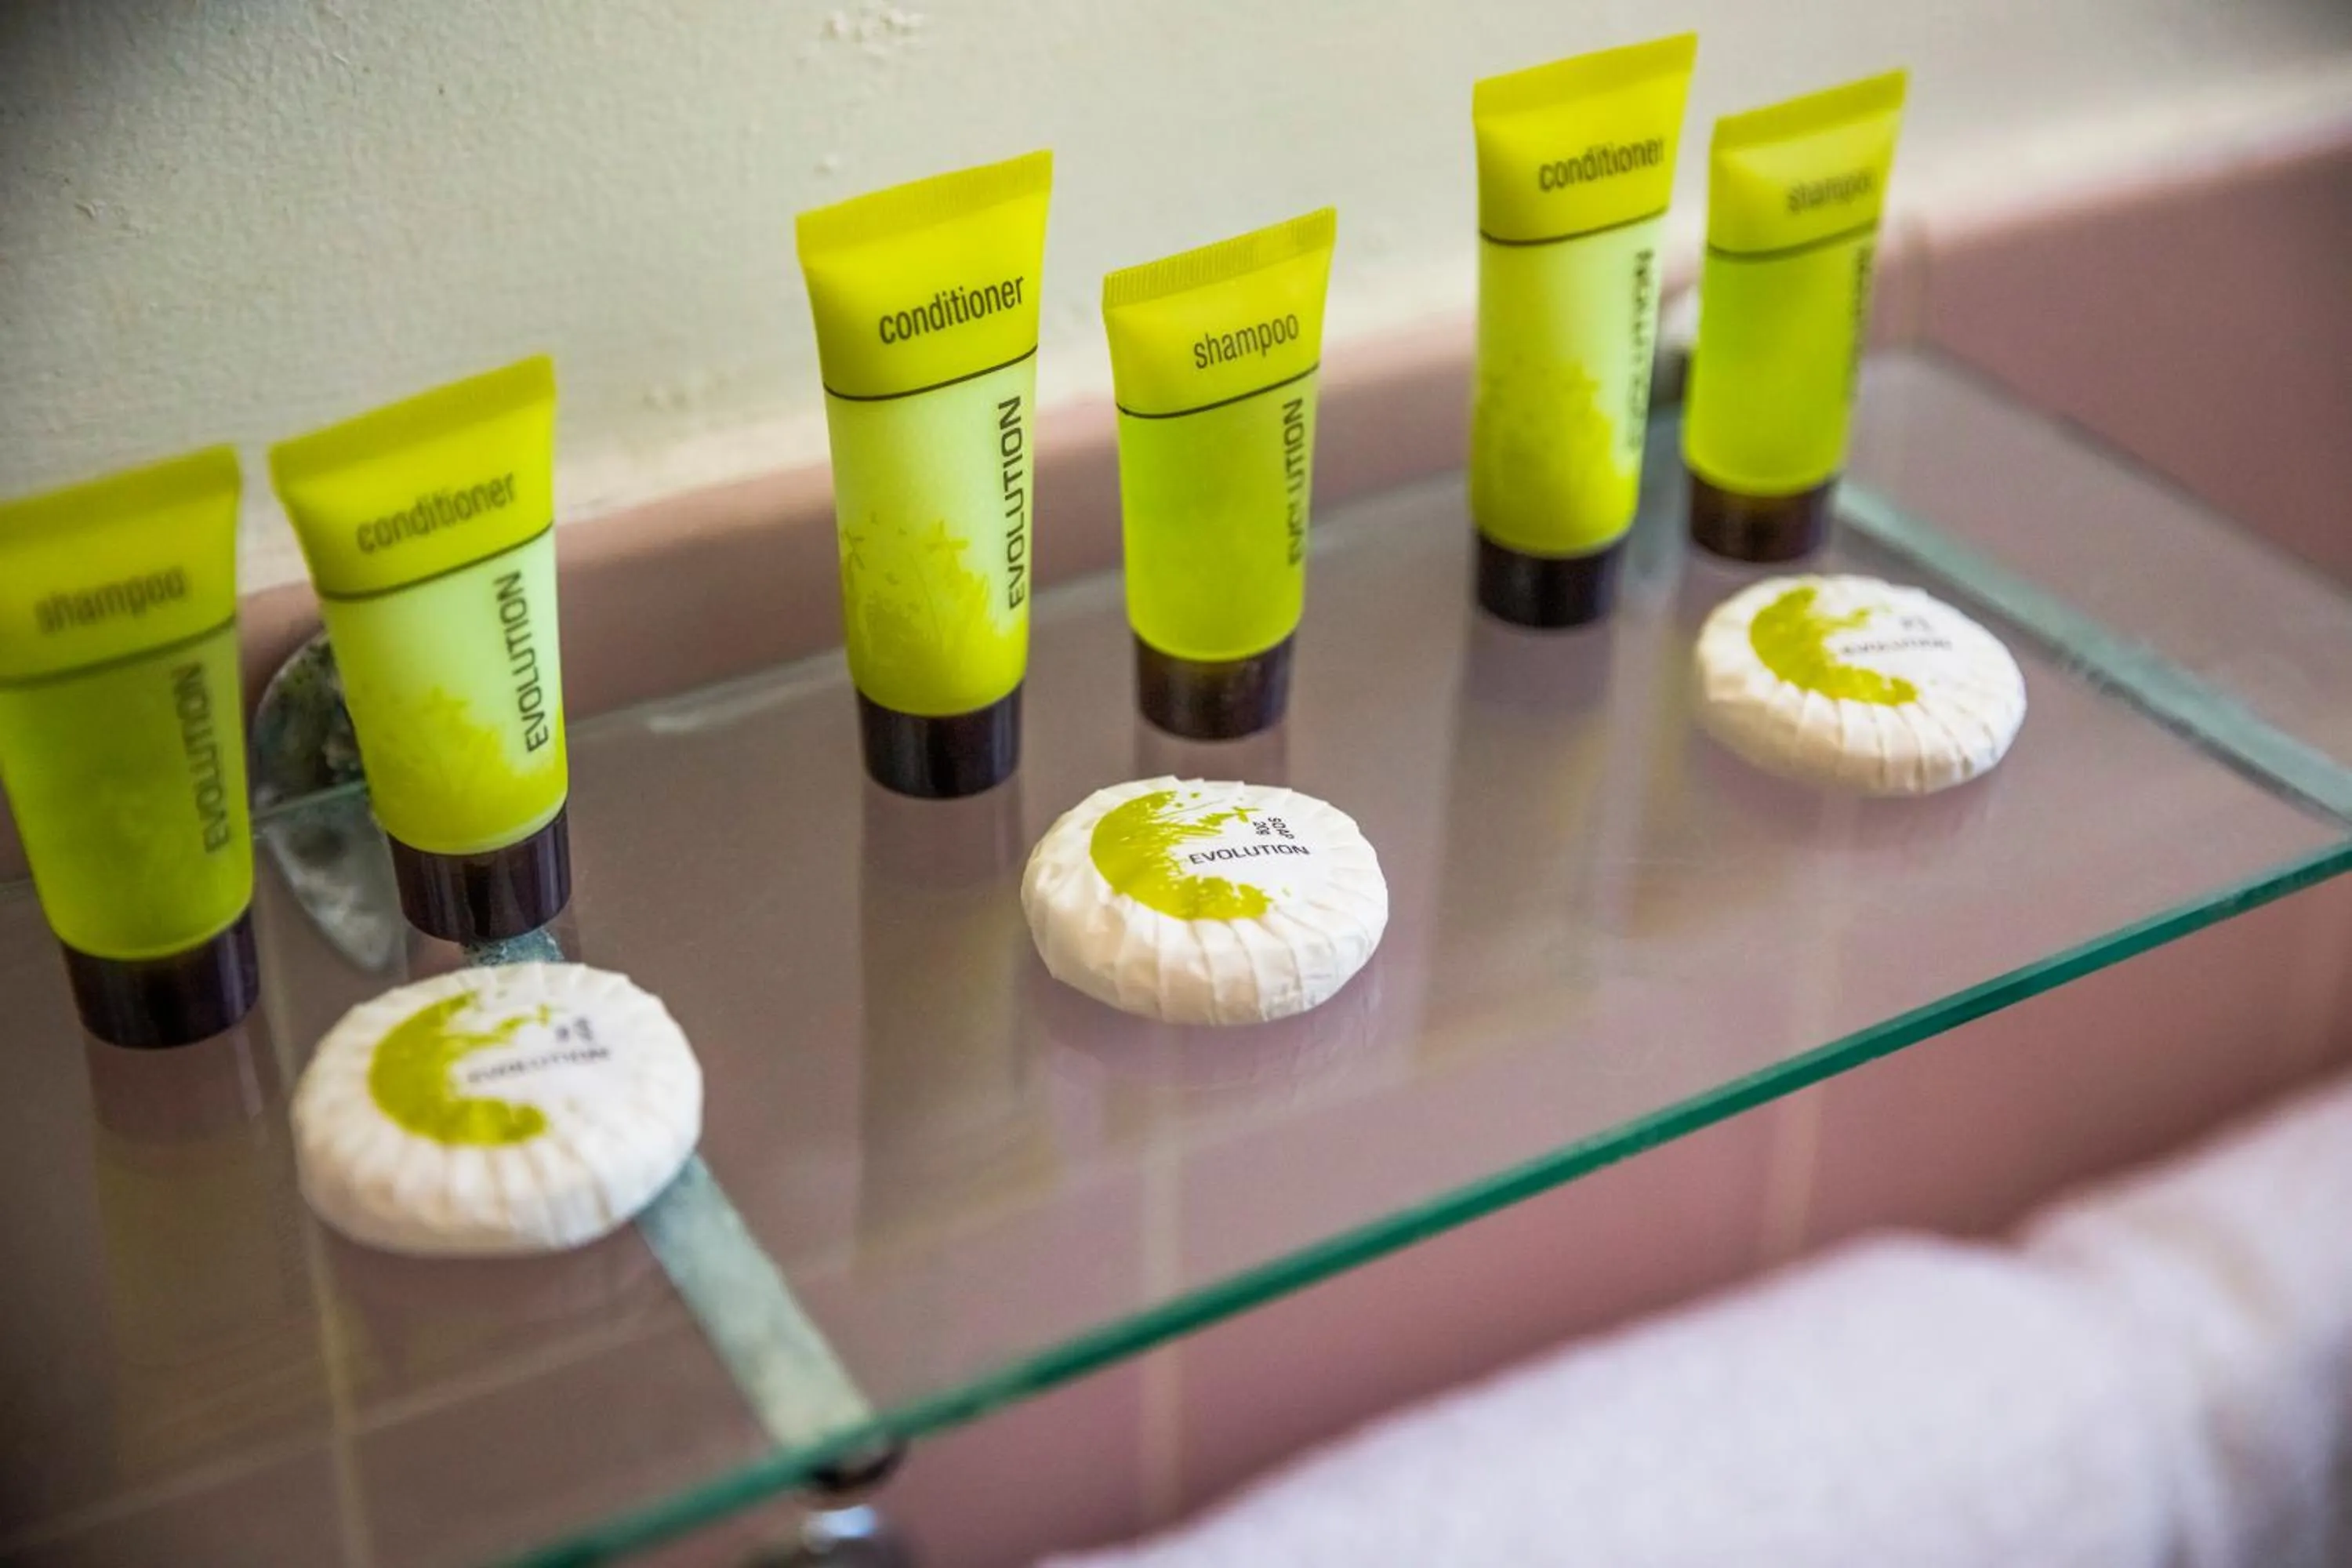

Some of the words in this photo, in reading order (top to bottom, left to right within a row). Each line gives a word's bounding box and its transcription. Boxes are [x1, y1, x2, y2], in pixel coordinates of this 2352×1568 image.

[879, 274, 1025, 346] conditioner
[1192, 313, 1300, 370] shampoo
[356, 472, 517, 554] conditioner
[998, 396, 1025, 610] EVOLUTION
[35, 564, 189, 639] shampoo
[492, 569, 550, 753] EVOLUTION
[170, 660, 230, 854] EVOLUTION
[1189, 844, 1309, 864] EVOLUTION
